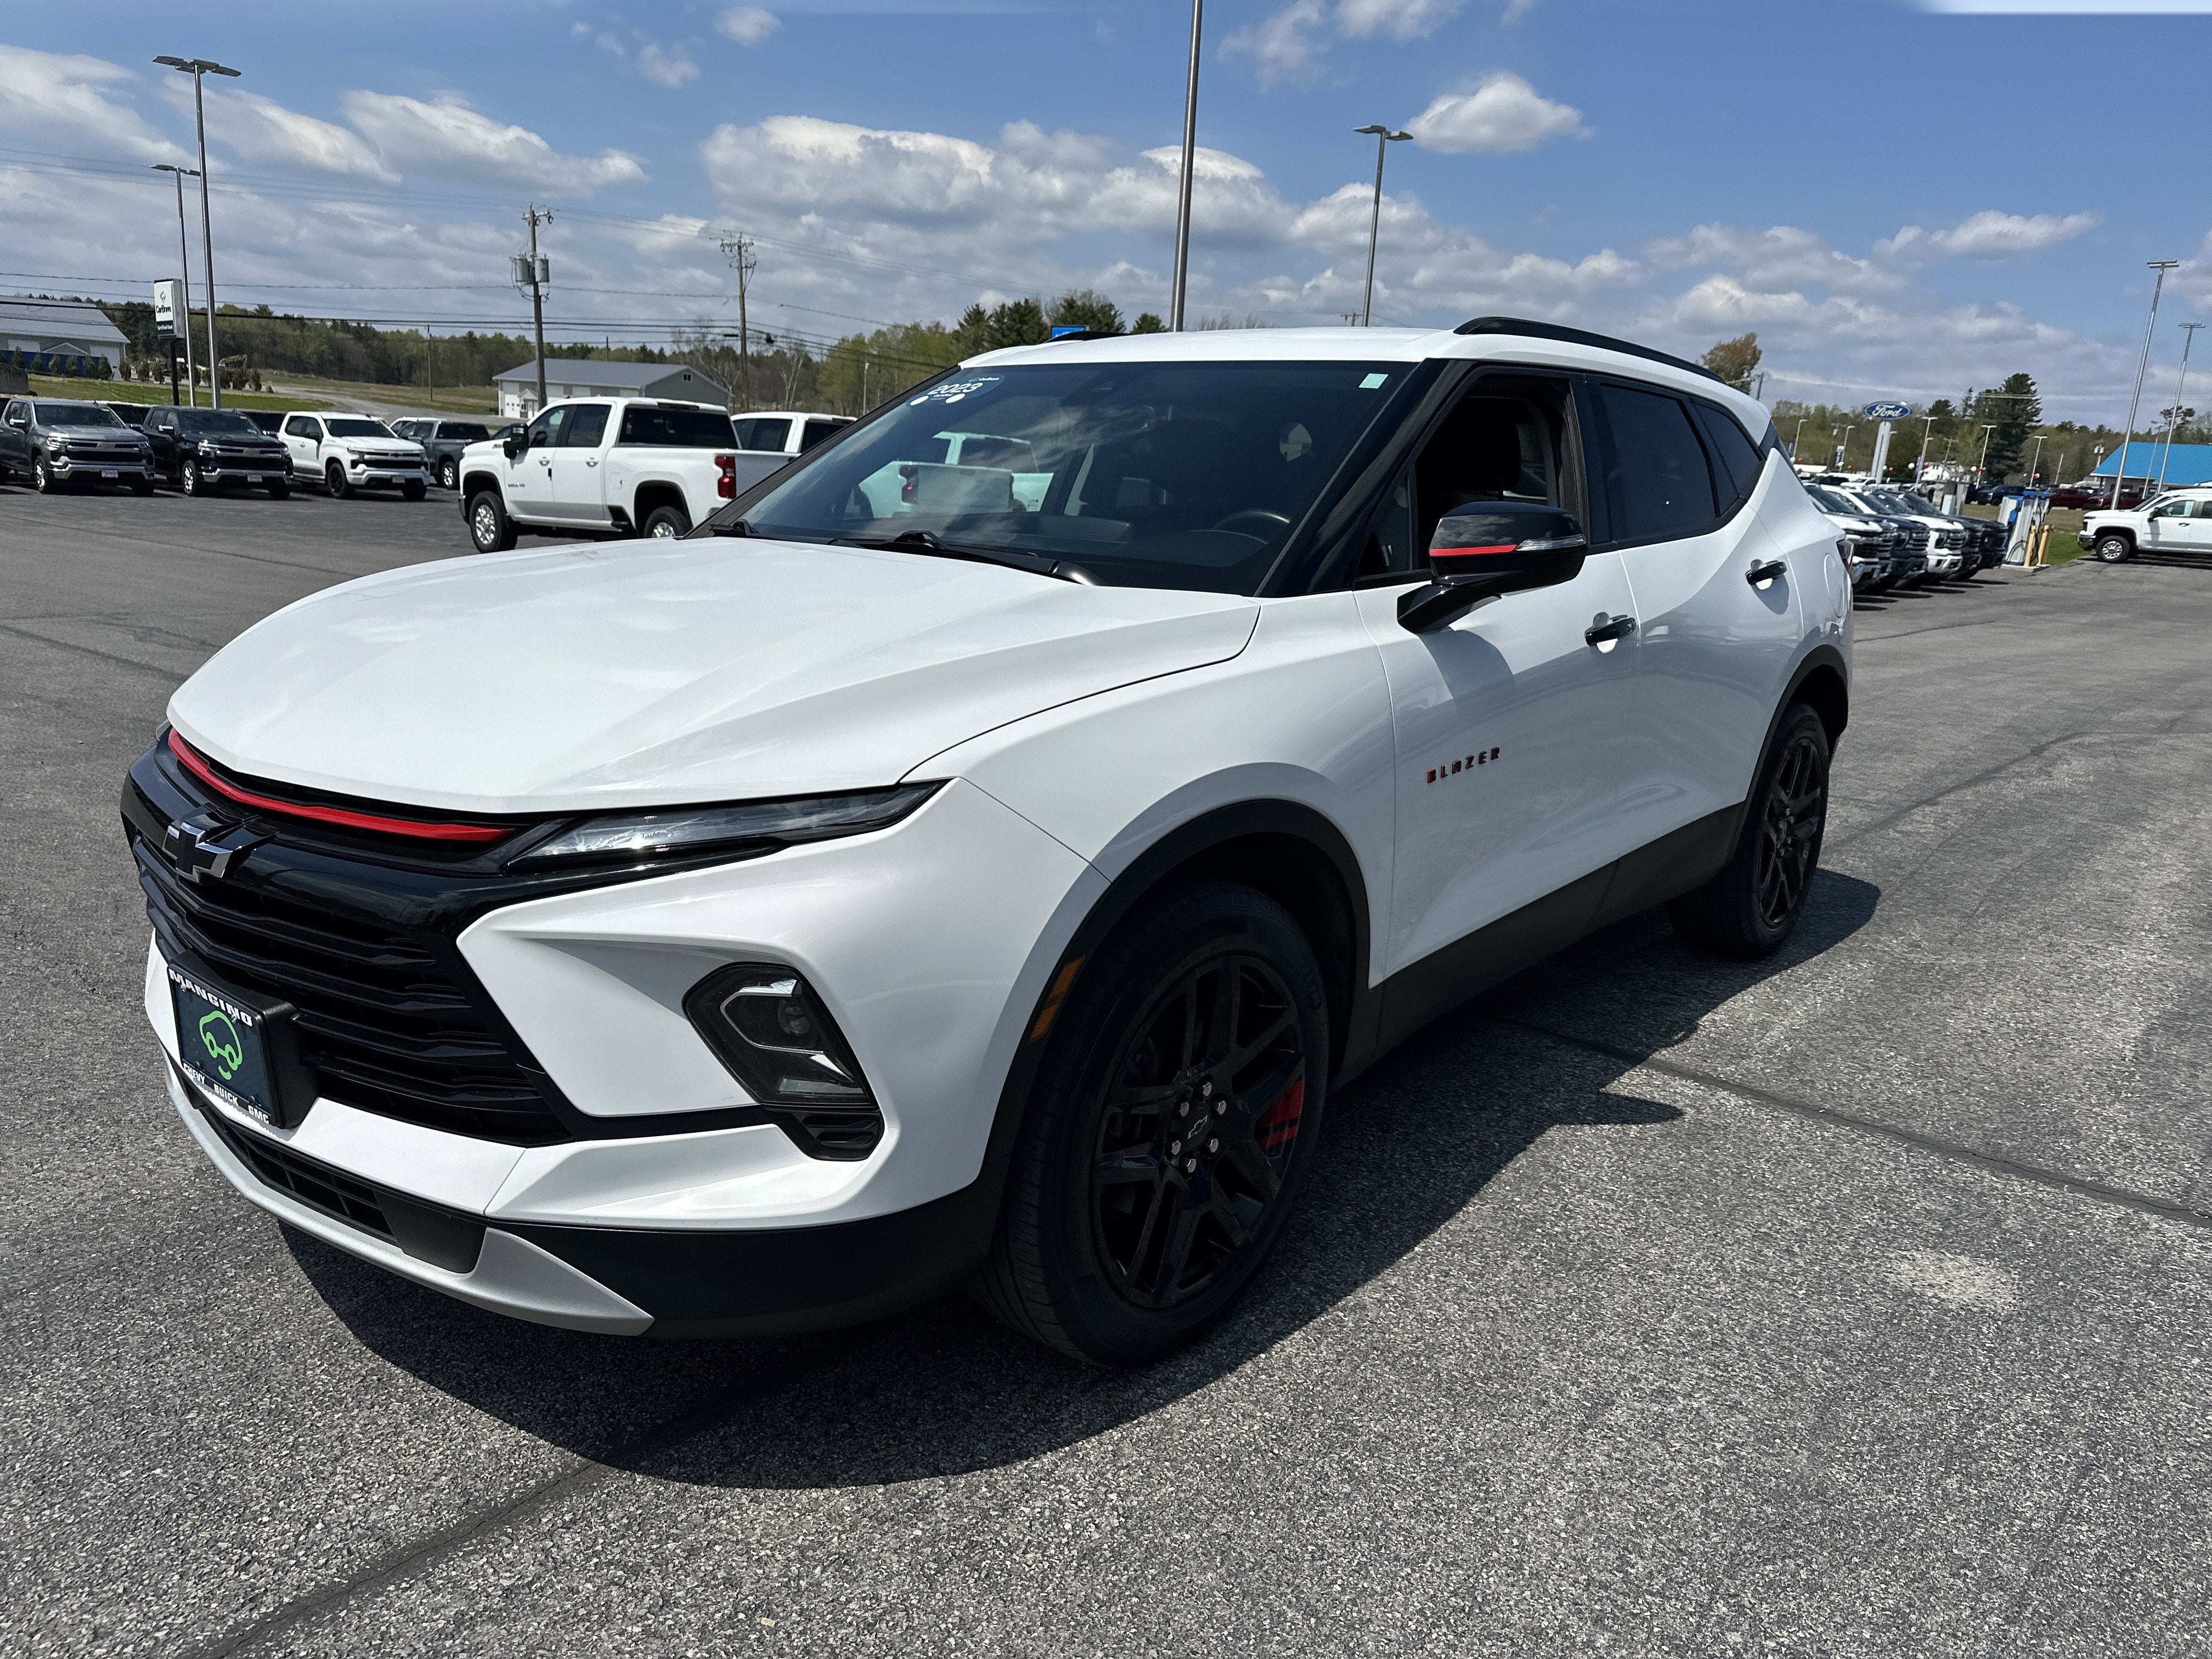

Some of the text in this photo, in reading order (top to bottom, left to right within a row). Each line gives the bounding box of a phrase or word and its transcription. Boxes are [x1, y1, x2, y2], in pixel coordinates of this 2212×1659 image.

[927, 382, 983, 395] 2023
[1872, 404, 1903, 417] Ford
[1426, 747, 1500, 784] BLAZER
[168, 968, 253, 1027] MANGINO
[183, 1063, 270, 1124] CHEVY BUICK GMC
